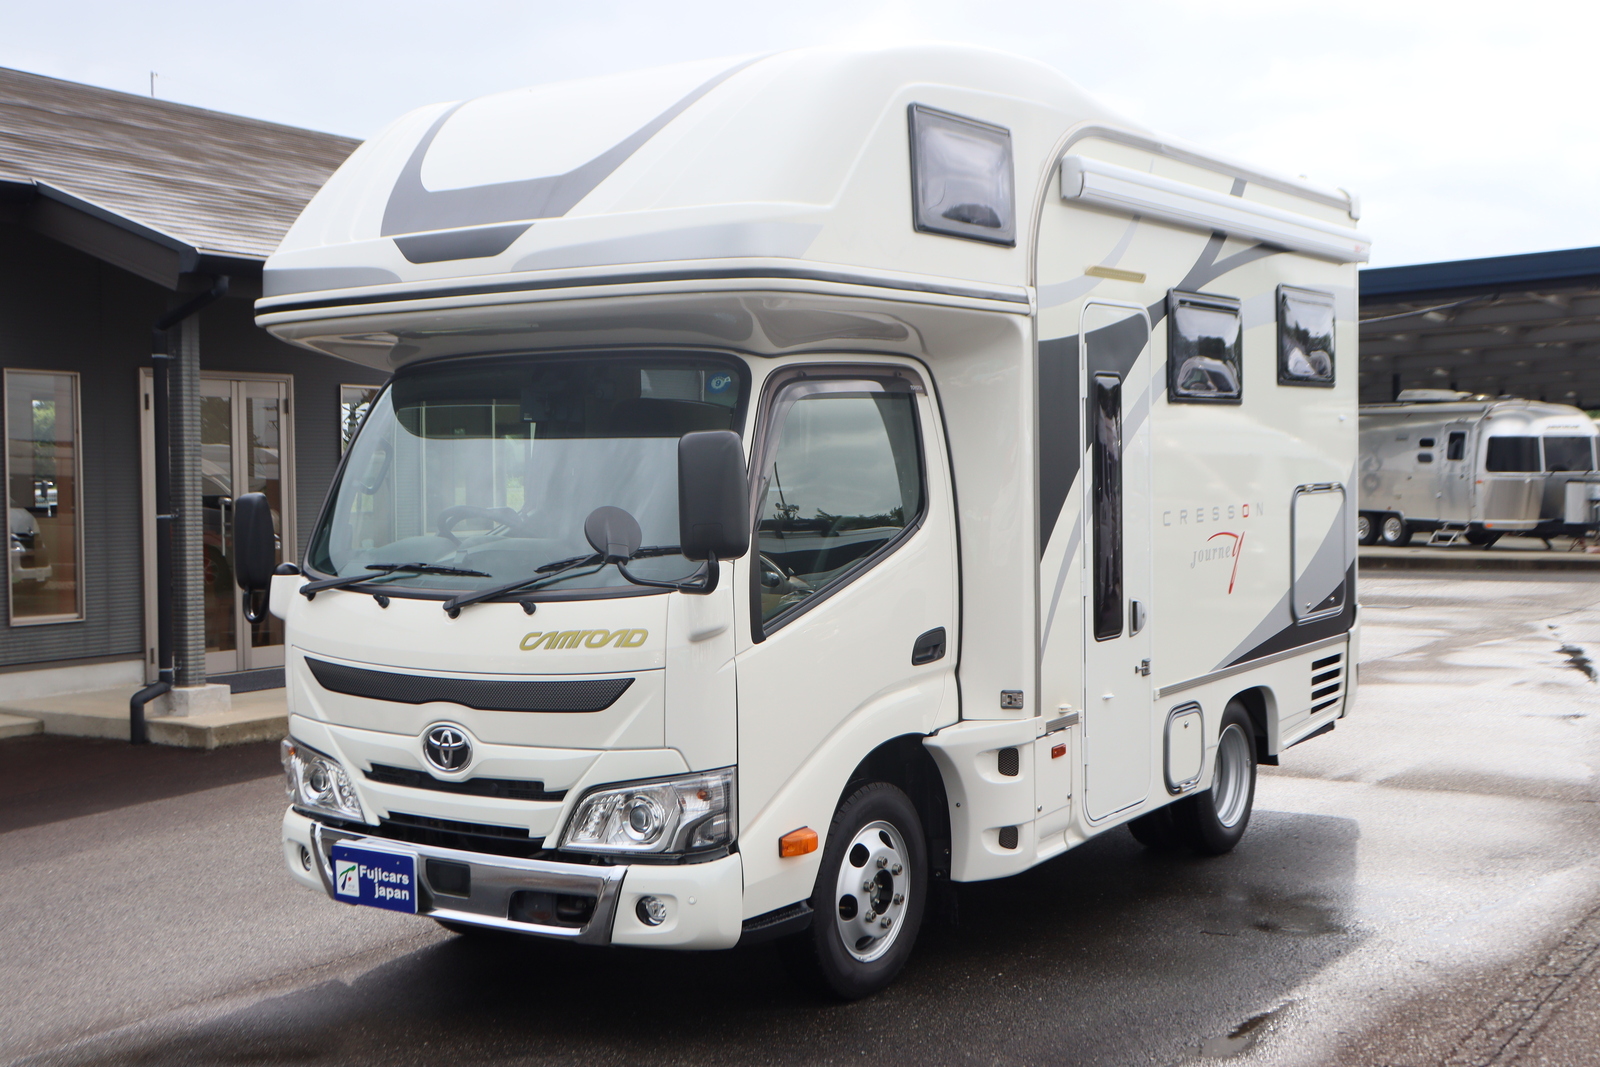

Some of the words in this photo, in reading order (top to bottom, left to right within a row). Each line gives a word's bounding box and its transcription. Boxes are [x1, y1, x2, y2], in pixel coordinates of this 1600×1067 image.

[1162, 502, 1264, 526] CRESSON
[519, 628, 649, 651] CAMROAD
[359, 865, 410, 885] Fujicars
[374, 883, 410, 901] japan
